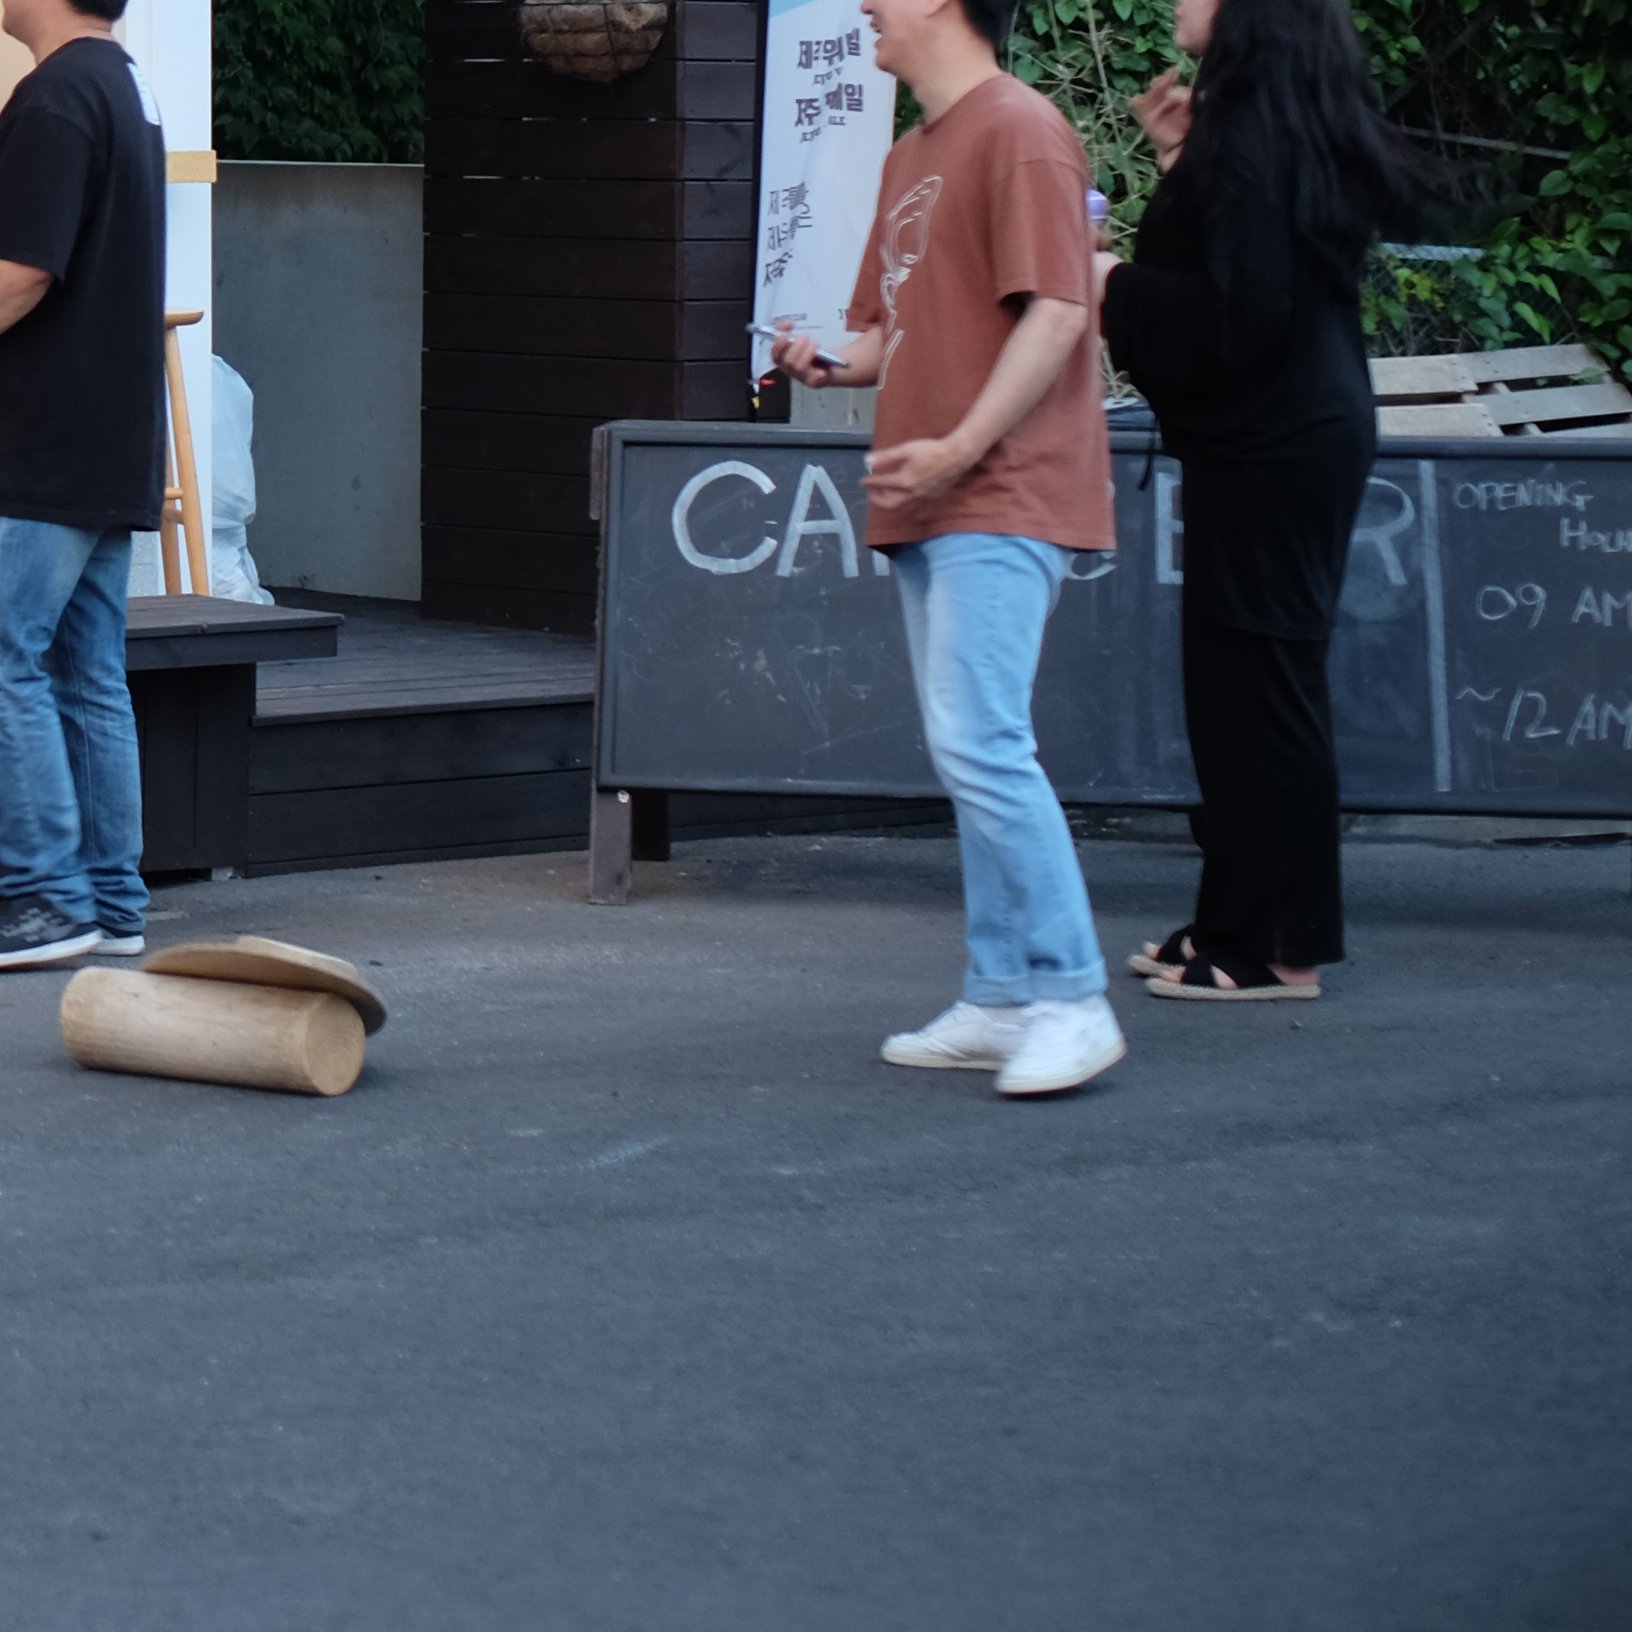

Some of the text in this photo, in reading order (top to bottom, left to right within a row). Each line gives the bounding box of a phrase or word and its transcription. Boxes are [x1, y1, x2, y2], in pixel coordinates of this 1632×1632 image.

[1452, 478, 1595, 511] OPENING
[1475, 582, 1632, 632] 09 AM
[1566, 693, 1632, 751] AM
